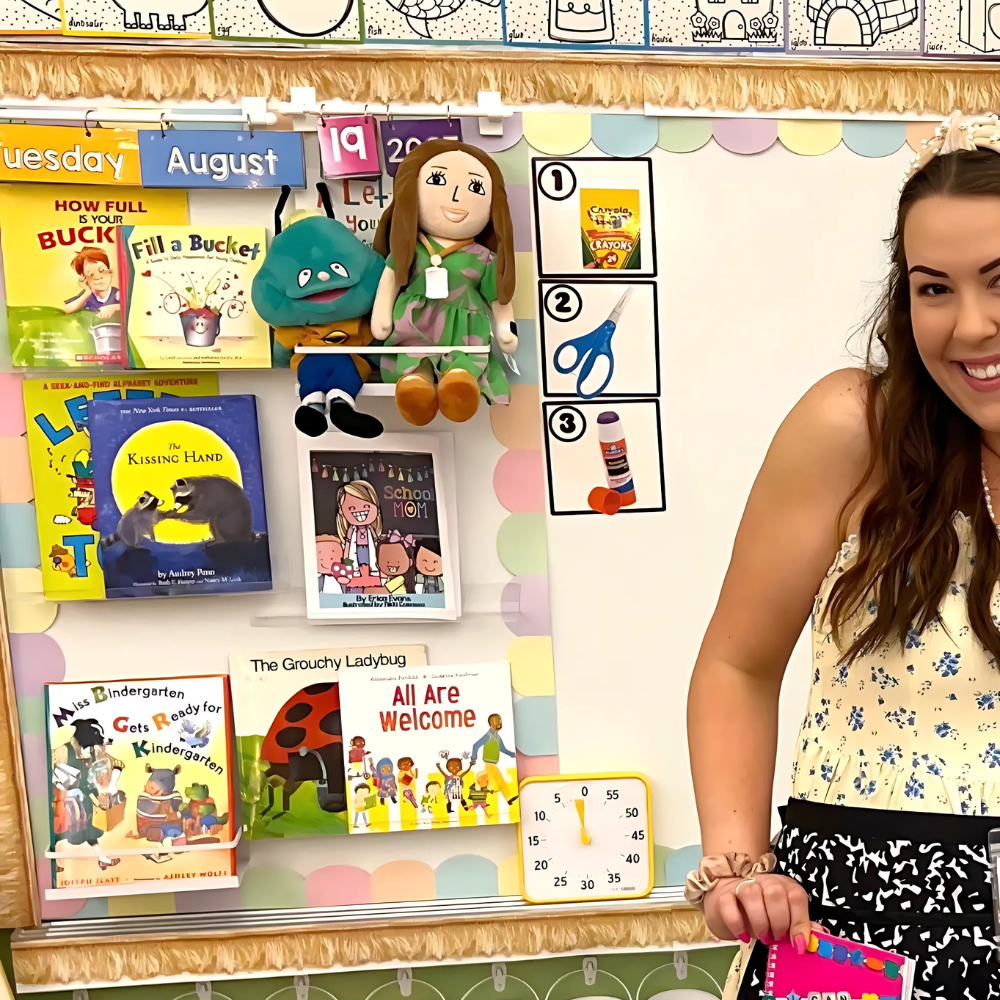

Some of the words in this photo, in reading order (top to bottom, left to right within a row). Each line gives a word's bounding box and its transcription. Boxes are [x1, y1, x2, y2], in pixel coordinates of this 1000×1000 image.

[68, 16, 103, 28] dinosaur
[368, 25, 382, 35] fish
[508, 29, 524, 43] glue
[651, 33, 673, 43] house
[329, 125, 368, 162] 19
[0, 143, 125, 180] uesday
[166, 145, 279, 181] August
[551, 169, 563, 191] 1
[55, 200, 100, 212] HOW
[105, 201, 147, 213] FULL
[79, 214, 88, 224] IS
[91, 215, 123, 224] YOUR
[37, 226, 116, 250] BUCK
[131, 235, 165, 260] Fill
[170, 239, 182, 252] a
[188, 234, 261, 261] Bucket
[589, 239, 633, 252] CRAYONS
[554, 291, 572, 313] 2
[154, 378, 198, 387] ADVENTURE
[558, 412, 576, 434] 3
[127, 453, 179, 465] KISSING
[184, 451, 223, 463] HAND
[393, 501, 428, 518] MOM
[157, 570, 167, 579] by
[168, 568, 195, 578] Audrey
[197, 568, 216, 576] Penn
[355, 595, 366, 603] By
[250, 658, 278, 673] The
[282, 655, 342, 671] Grouchy
[346, 653, 407, 669] Ladybug
[392, 684, 416, 706] All
[424, 684, 460, 704] Are
[52, 698, 91, 728] Miss
[90, 685, 185, 704] Bindergarten
[112, 716, 149, 733] Gets
[151, 703, 201, 731] Ready
[202, 700, 222, 714] for
[379, 708, 477, 732] Welcome
[132, 739, 224, 775] Kindergarten
[581, 786, 589, 797] 0
[606, 789, 619, 800] 55
[554, 793, 561, 803] 5
[534, 810, 546, 821] 10
[625, 807, 639, 818] 50
[528, 835, 540, 846] 15
[631, 829, 645, 840] 45
[625, 853, 640, 864] 40
[534, 860, 548, 870] 20
[554, 876, 567, 886] 25
[607, 872, 621, 884] 35
[580, 879, 595, 890] 30
